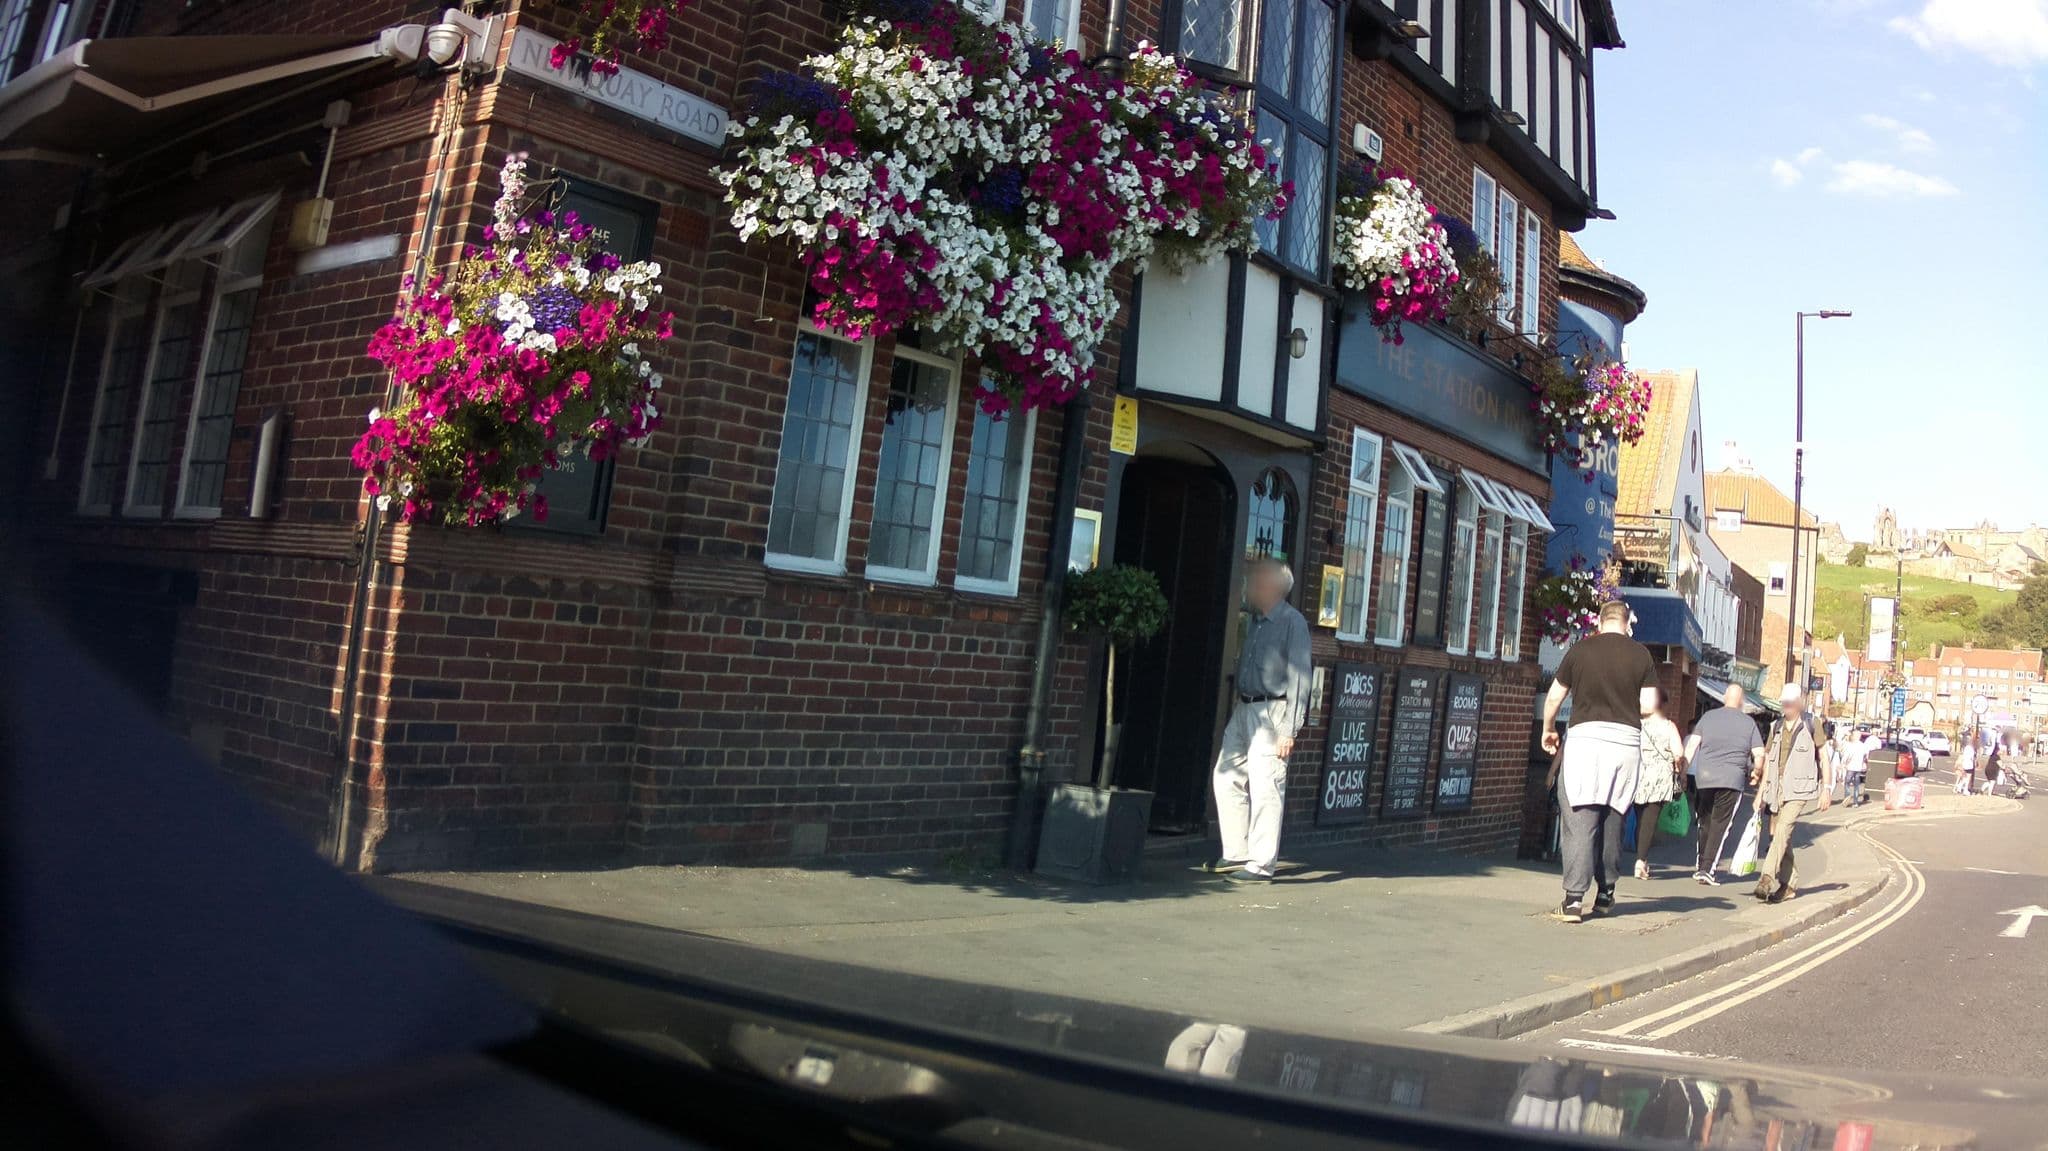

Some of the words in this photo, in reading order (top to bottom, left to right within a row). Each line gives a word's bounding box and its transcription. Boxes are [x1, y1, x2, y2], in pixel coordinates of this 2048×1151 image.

[659, 93, 720, 135] ROAD
[1376, 332, 1416, 383] THE
[1423, 357, 1499, 424] STATION
[1453, 696, 1478, 710] ROOMS
[1342, 721, 1366, 741] LIVE
[1447, 724, 1471, 750] QUIZ
[1333, 742, 1369, 762] SPORT
[1325, 770, 1337, 810] 8
[1338, 769, 1366, 790] CASK
[1336, 793, 1363, 808] PUMPS
